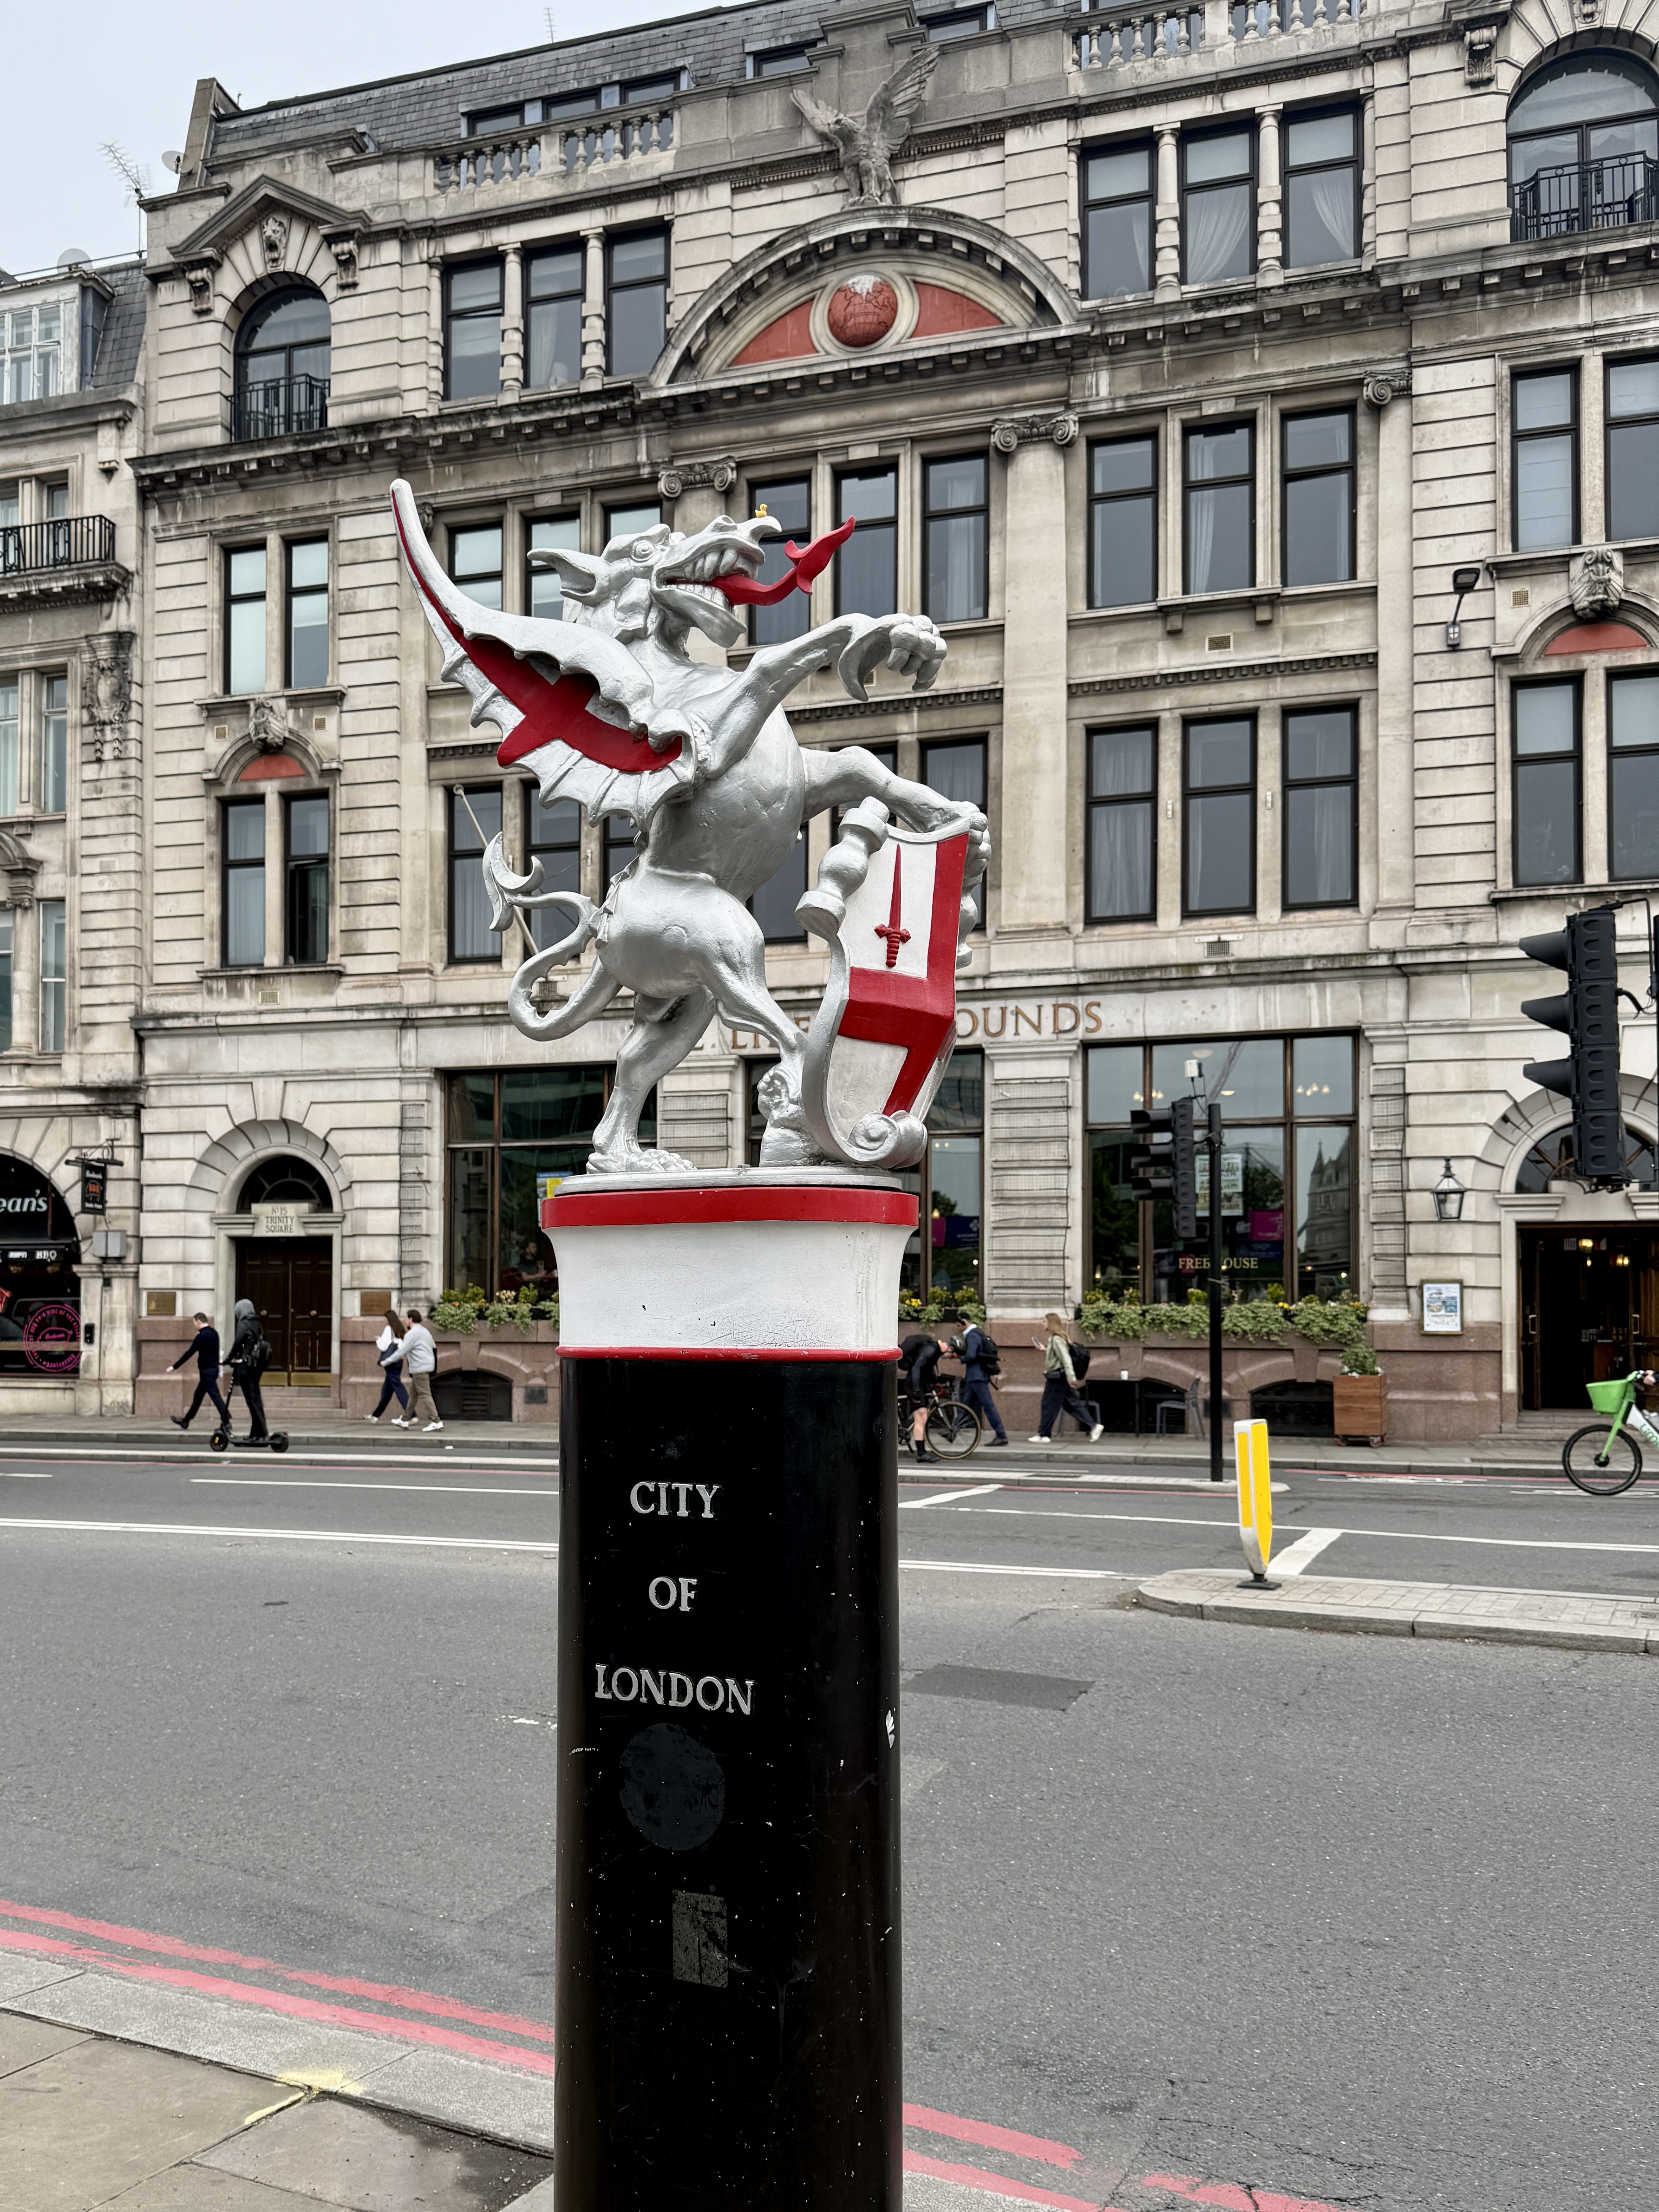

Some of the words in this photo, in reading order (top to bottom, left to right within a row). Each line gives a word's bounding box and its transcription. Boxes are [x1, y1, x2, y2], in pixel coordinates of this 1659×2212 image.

[956, 1001, 1102, 1039] OUNDS
[265, 1216, 294, 1224] TRINITY
[265, 1224, 294, 1234] SQUARE
[1222, 1257, 1258, 1269] OUSE
[630, 1481, 720, 1518] CITY
[648, 1577, 698, 1612] OF
[594, 1664, 754, 1715] LONDON
